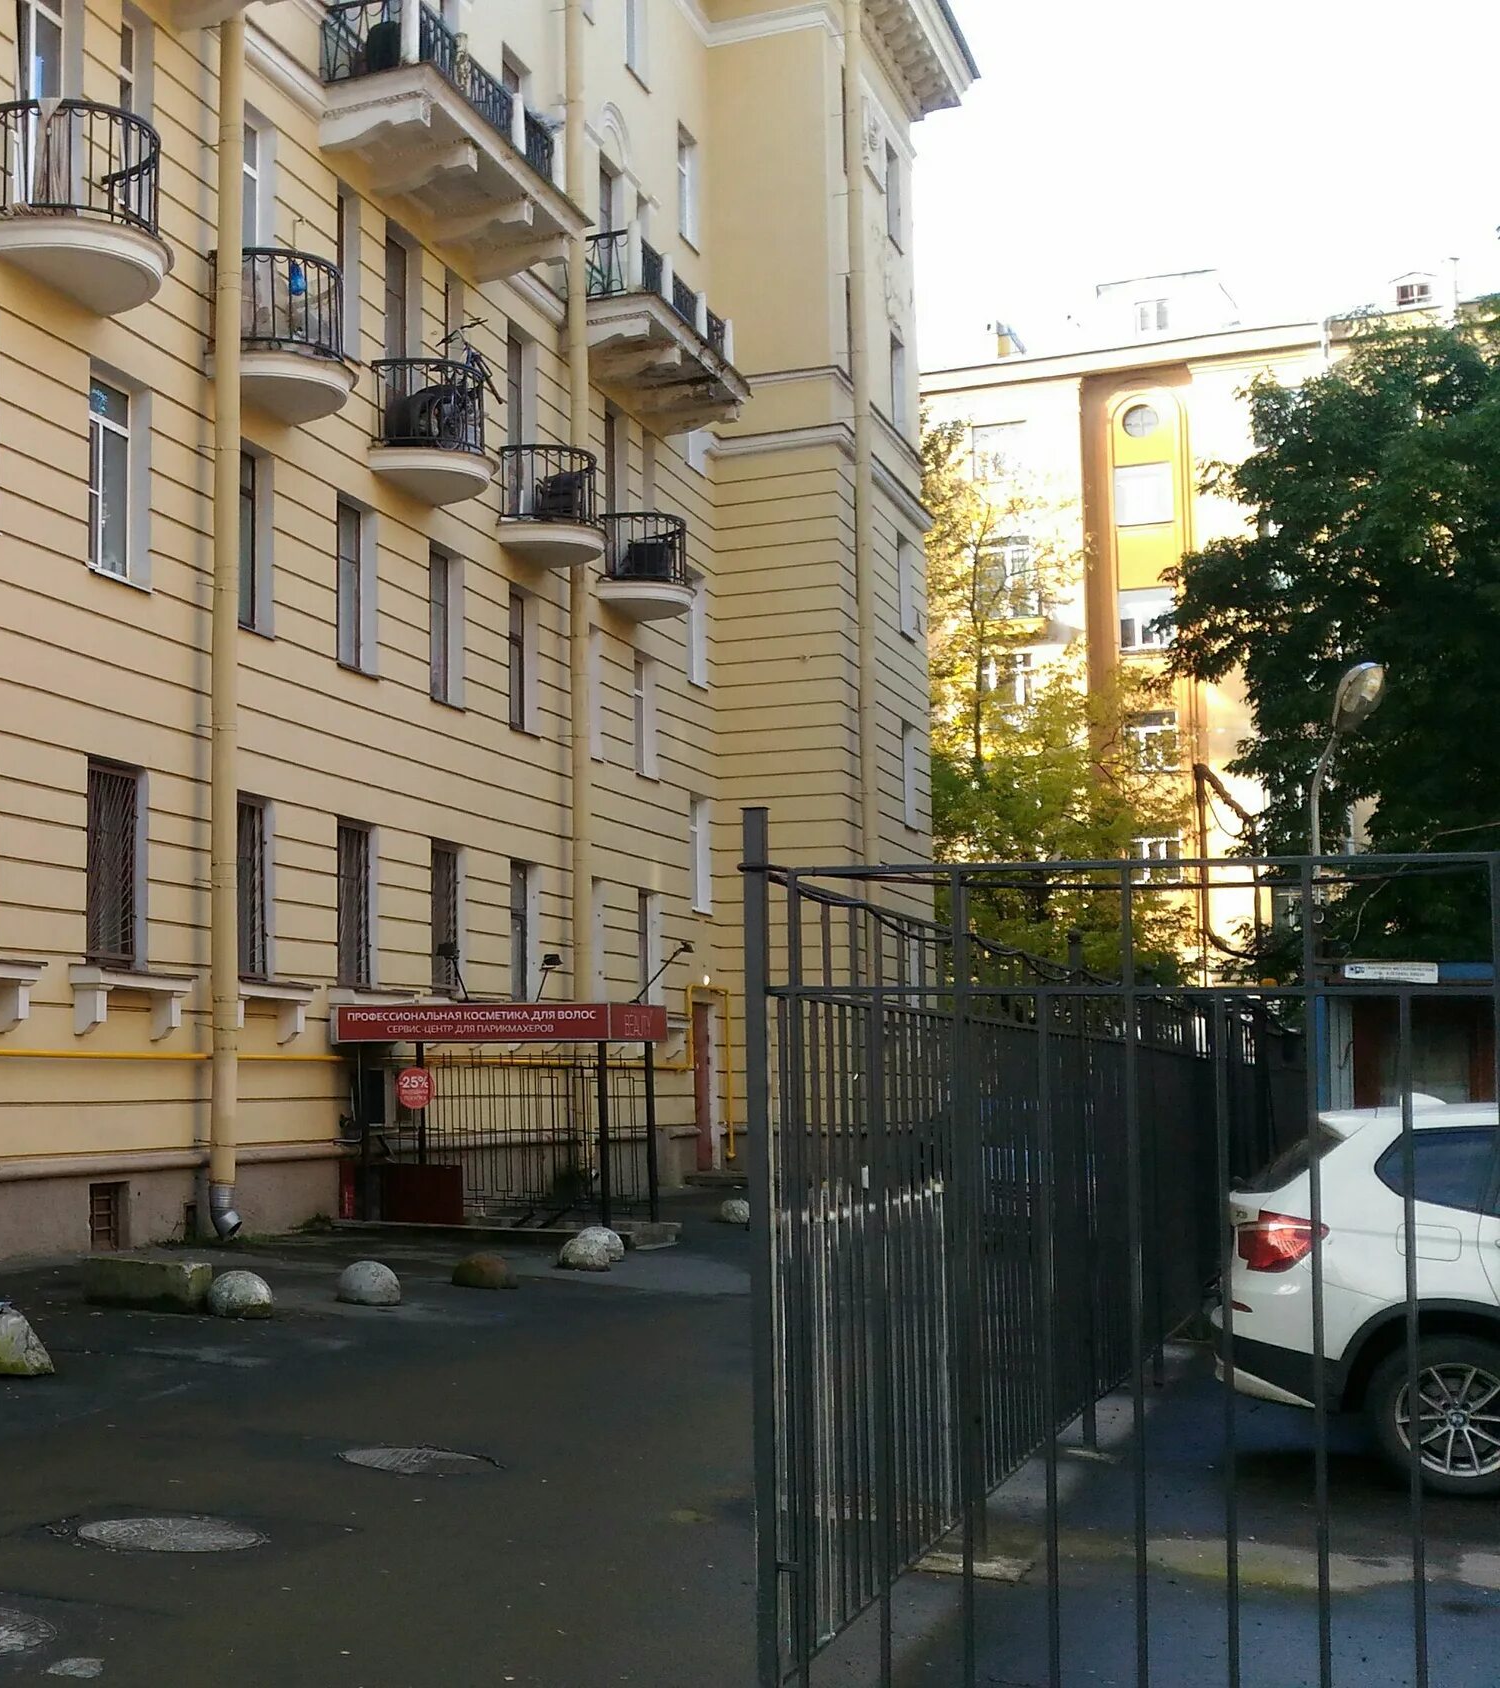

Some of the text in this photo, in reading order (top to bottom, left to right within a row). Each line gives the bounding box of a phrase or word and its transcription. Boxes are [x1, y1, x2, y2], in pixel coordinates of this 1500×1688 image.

[347, 1010, 597, 1022] ПРОФЕССИОНАЛЬНАЯ КОСМЕТИКА ДЛЯ ВОЛОС
[387, 1024, 554, 1034] СЕРВИС-ЦЕНТР ДЛЯ ПАРИКМАХЕРОВ
[398, 1075, 429, 1089] -25%
